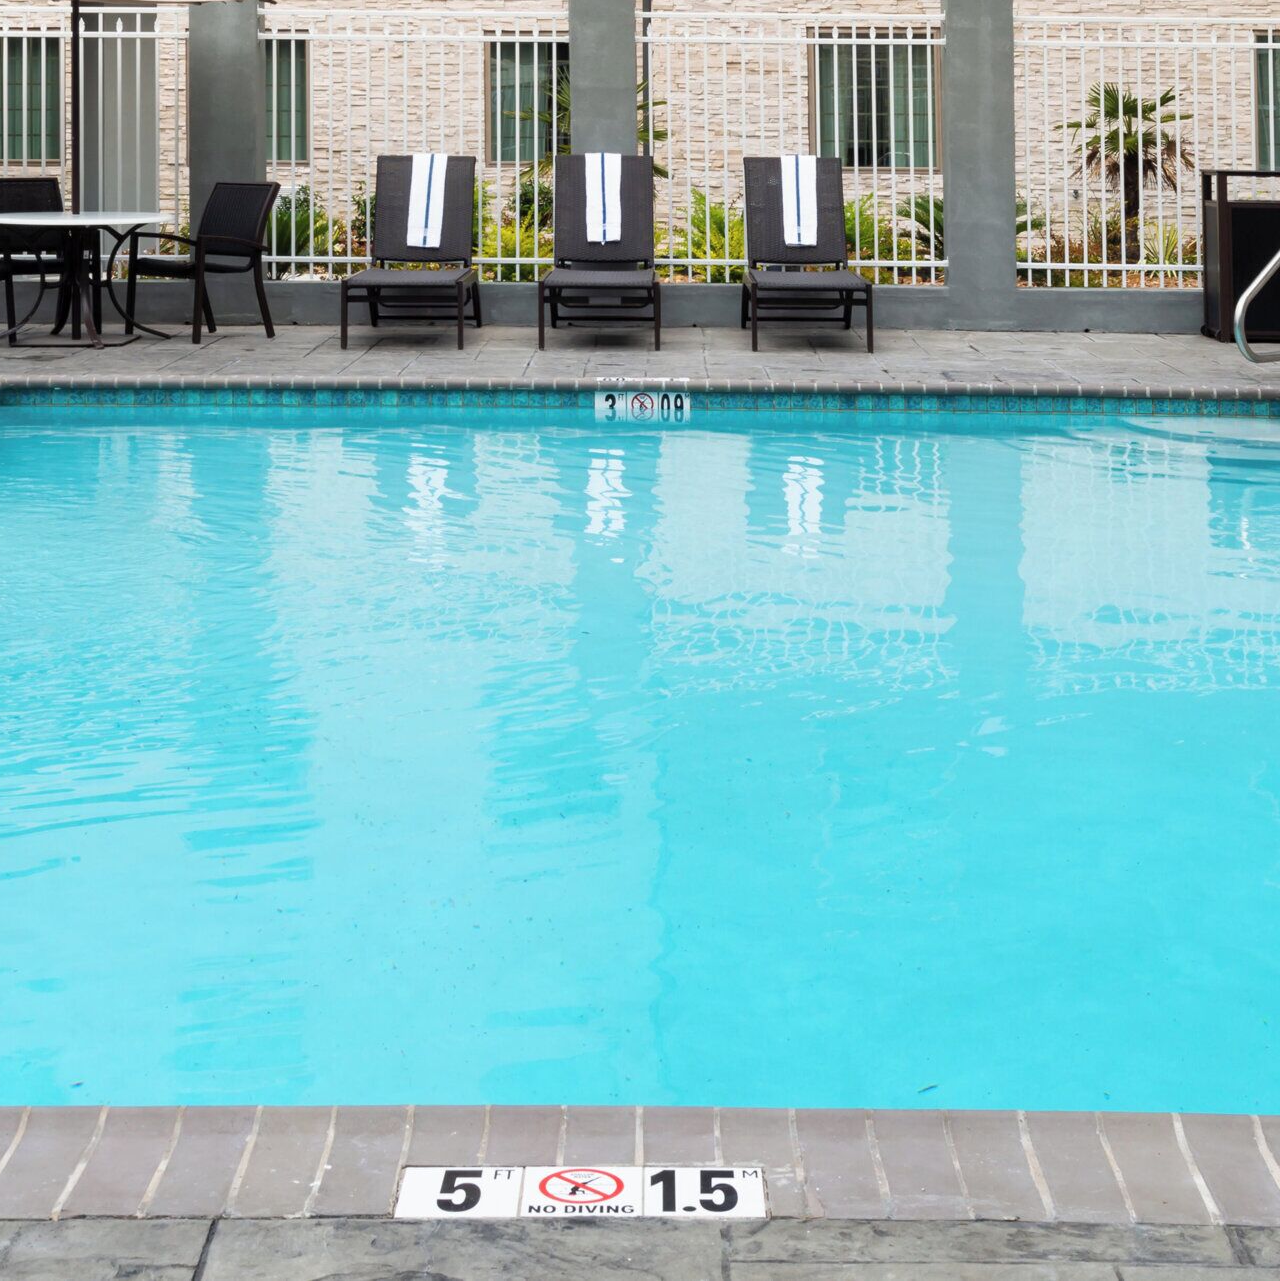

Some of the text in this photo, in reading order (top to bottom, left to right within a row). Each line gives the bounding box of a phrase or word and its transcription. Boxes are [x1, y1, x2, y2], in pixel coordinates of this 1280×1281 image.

[436, 1169, 516, 1213] 5 FT
[528, 1205, 635, 1214] NO DIVING
[650, 1169, 758, 1213] 1.5 M
